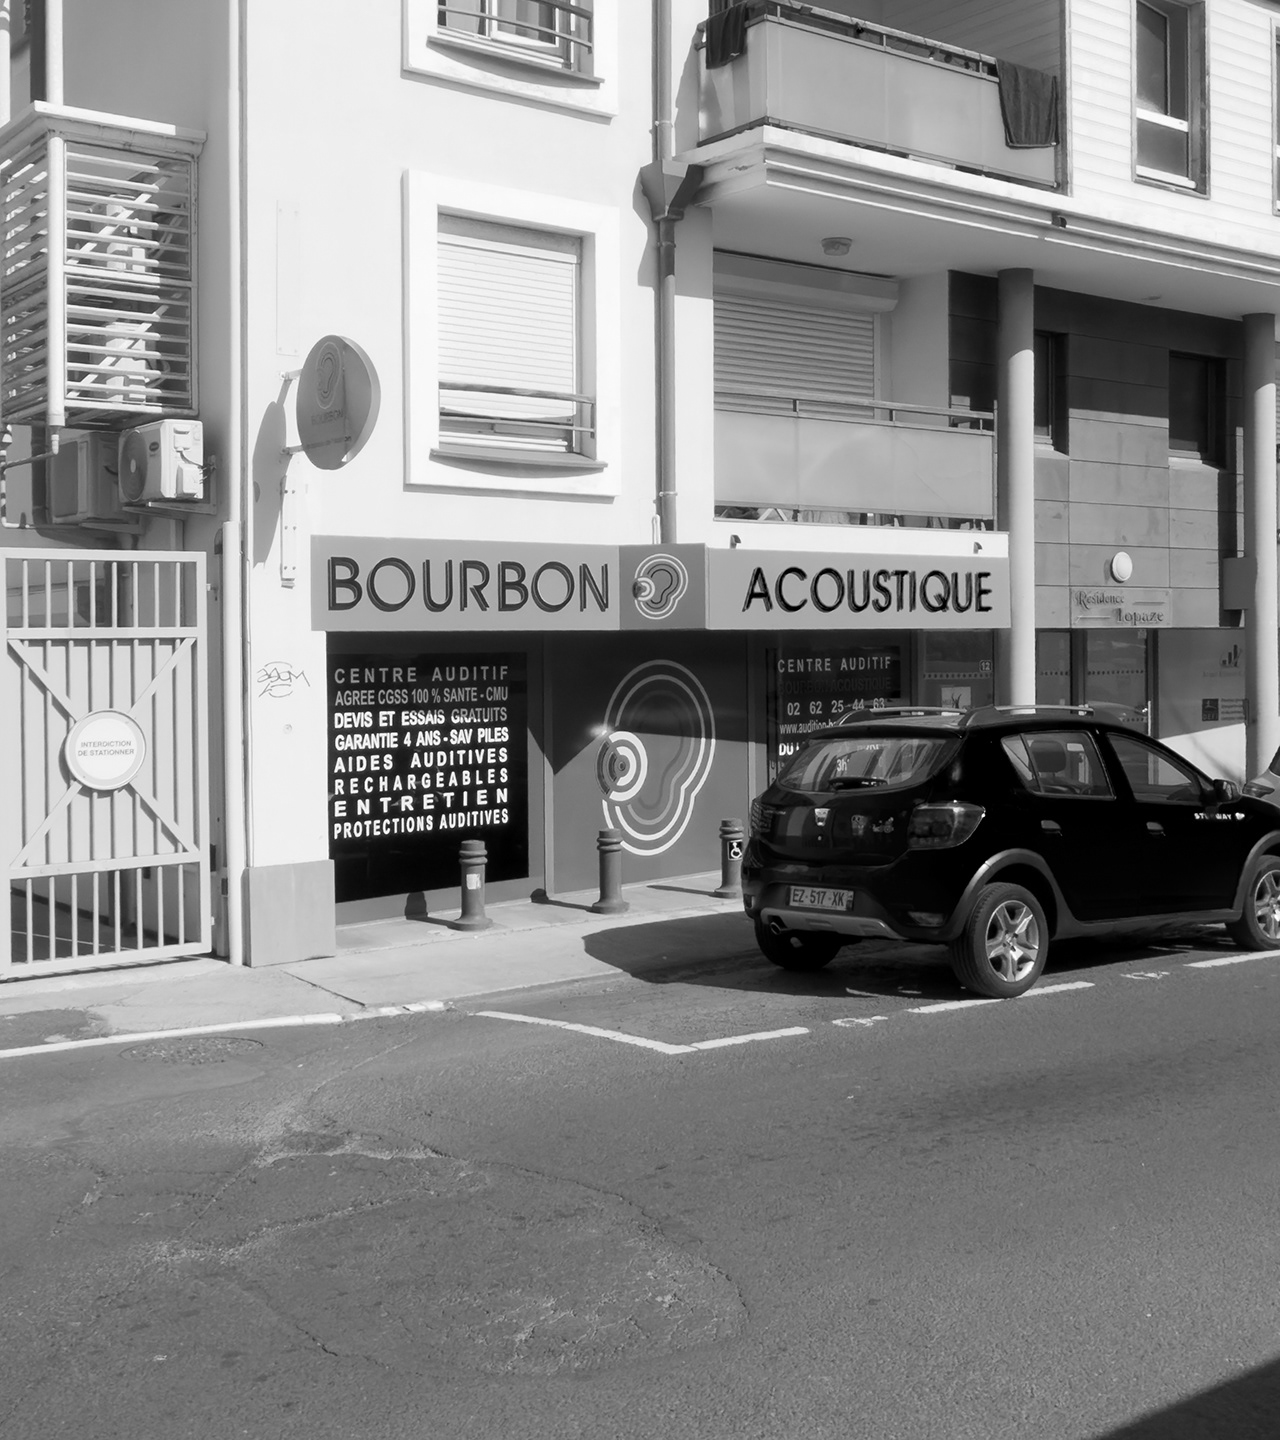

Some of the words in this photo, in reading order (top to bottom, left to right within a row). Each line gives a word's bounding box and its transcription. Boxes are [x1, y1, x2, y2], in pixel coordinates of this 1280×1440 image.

[326, 556, 609, 614] BOURBON
[741, 565, 993, 614] ACOUSTIQUE
[334, 667, 418, 684] CENTRE
[431, 666, 508, 682] AUDITIF
[777, 658, 831, 673] CENTRE
[840, 656, 891, 671] AUDITIF
[981, 661, 990, 671] 12
[335, 689, 375, 706] AGREE
[377, 689, 409, 705] CGSS
[411, 688, 429, 703] 100
[431, 688, 441, 703] %
[443, 687, 478, 703] SANTE
[485, 686, 508, 701] CMU
[787, 702, 800, 716] 02
[809, 701, 822, 715] 62
[831, 700, 844, 713] 25
[852, 698, 864, 710] 44
[873, 698, 885, 709] 63
[334, 711, 373, 729] DEVIS
[378, 710, 396, 727] ET
[401, 709, 445, 727] ESSAIS
[450, 707, 507, 724] GRATUITS
[81, 740, 132, 748] INTERDICTION
[334, 732, 399, 751] GARANTIE
[403, 732, 411, 747] 4
[477, 727, 509, 744] PILES
[90, 748, 135, 756] STATIONNER
[334, 754, 393, 773] AIDES
[410, 747, 508, 768] AUDITIVES
[334, 768, 508, 795] RECHARGEABLES
[334, 788, 508, 817] ENTRETIEN
[334, 815, 434, 840] PROTECTIONS
[439, 808, 509, 830] AUDITIVES
